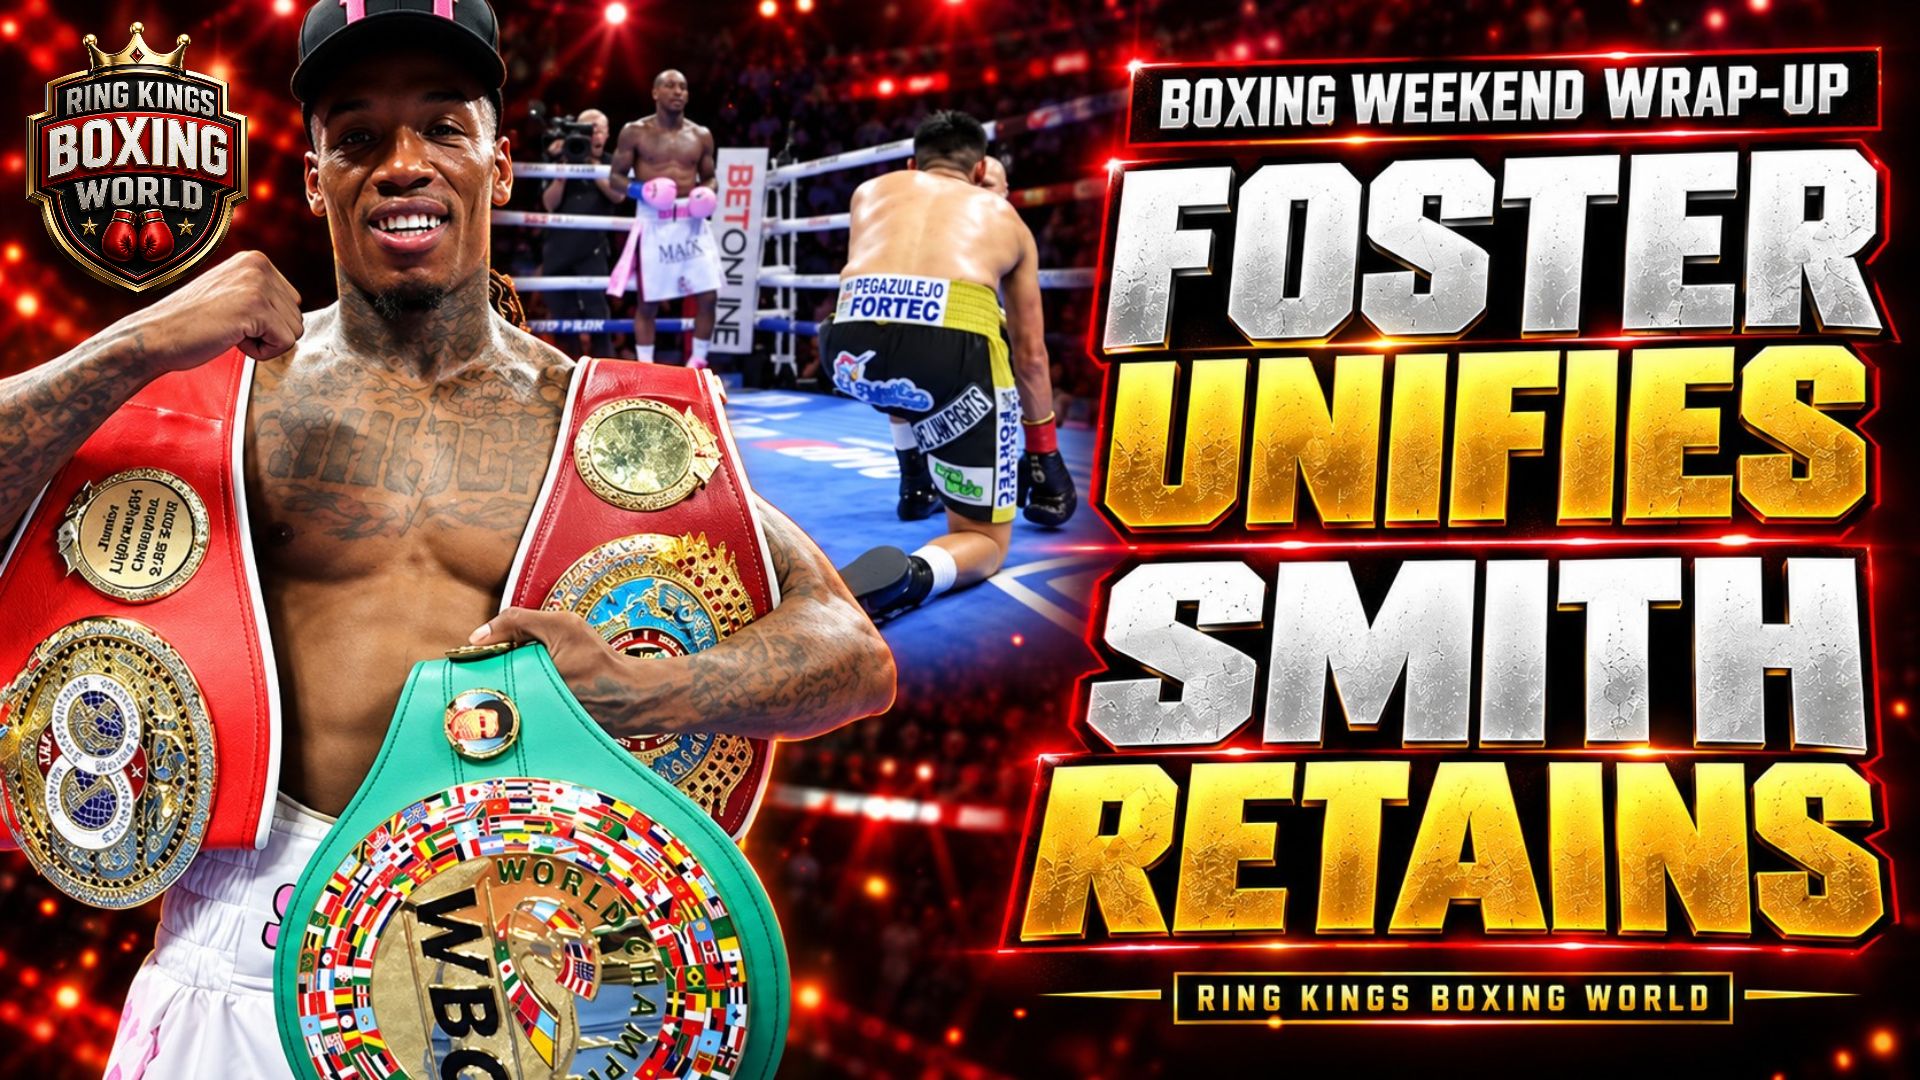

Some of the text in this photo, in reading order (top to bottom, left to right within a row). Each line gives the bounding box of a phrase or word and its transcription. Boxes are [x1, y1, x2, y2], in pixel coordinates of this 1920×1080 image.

[849, 297, 941, 322] FORTEC
[855, 277, 944, 299] PEGAZULEJO
[498, 859, 628, 929] WORLD
[416, 886, 511, 1080] WBC
